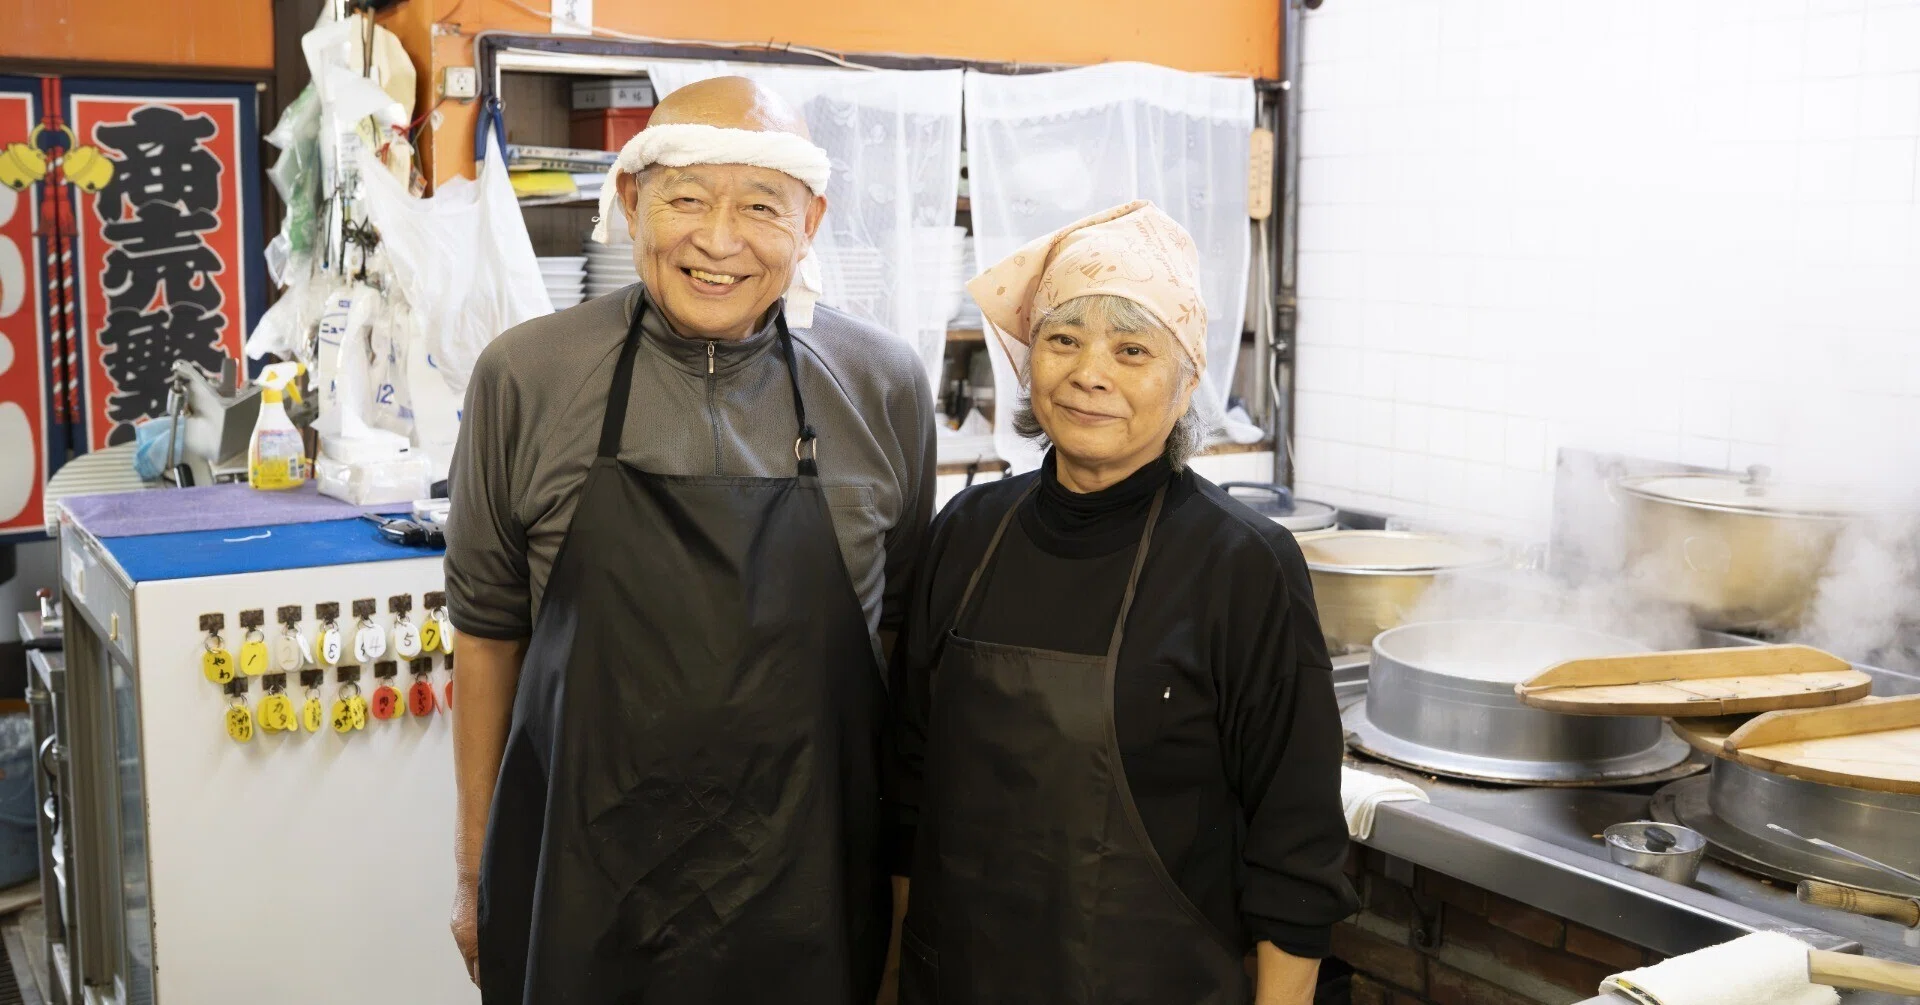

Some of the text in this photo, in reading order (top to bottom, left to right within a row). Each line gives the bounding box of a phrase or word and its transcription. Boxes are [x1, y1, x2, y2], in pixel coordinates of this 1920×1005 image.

[94, 104, 227, 446] 商売繁
[376, 384, 394, 404] 12
[404, 632, 414, 647] 5
[426, 628, 435, 646] 7
